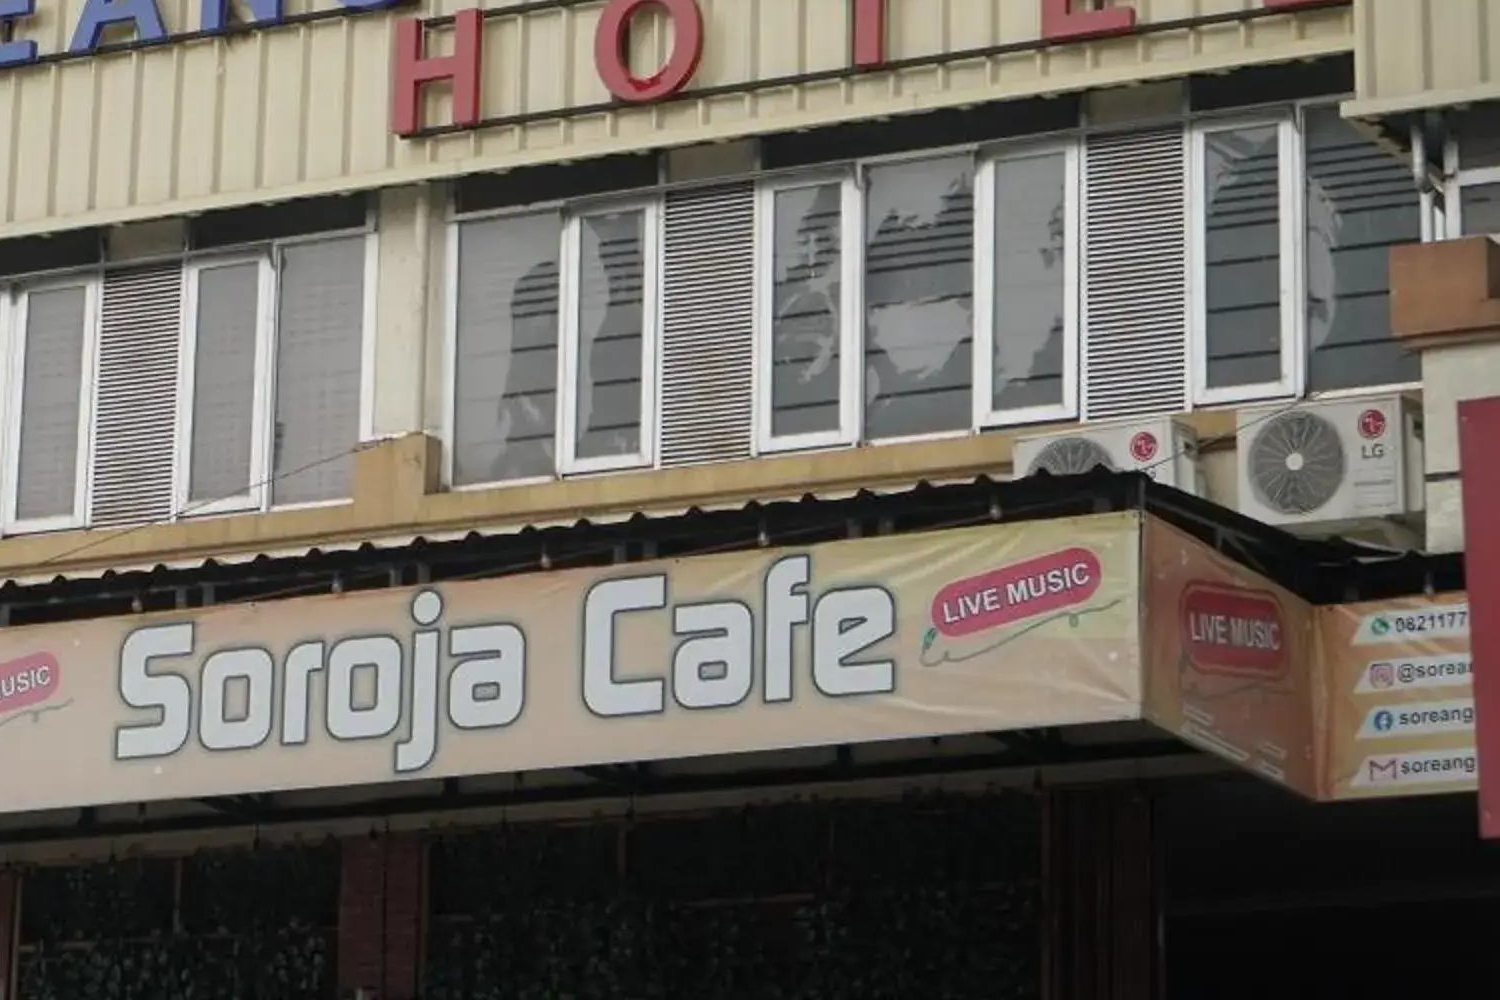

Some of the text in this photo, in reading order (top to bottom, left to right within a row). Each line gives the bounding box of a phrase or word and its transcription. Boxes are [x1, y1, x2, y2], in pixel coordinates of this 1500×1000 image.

[1361, 443, 1386, 459] LG
[942, 562, 1091, 624] LIVE MUSIC
[1189, 611, 1280, 652] LIVE MUSIC
[115, 553, 896, 773] Soroja Cafe
[1398, 706, 1474, 726] soreang
[1400, 756, 1476, 775] soreang
